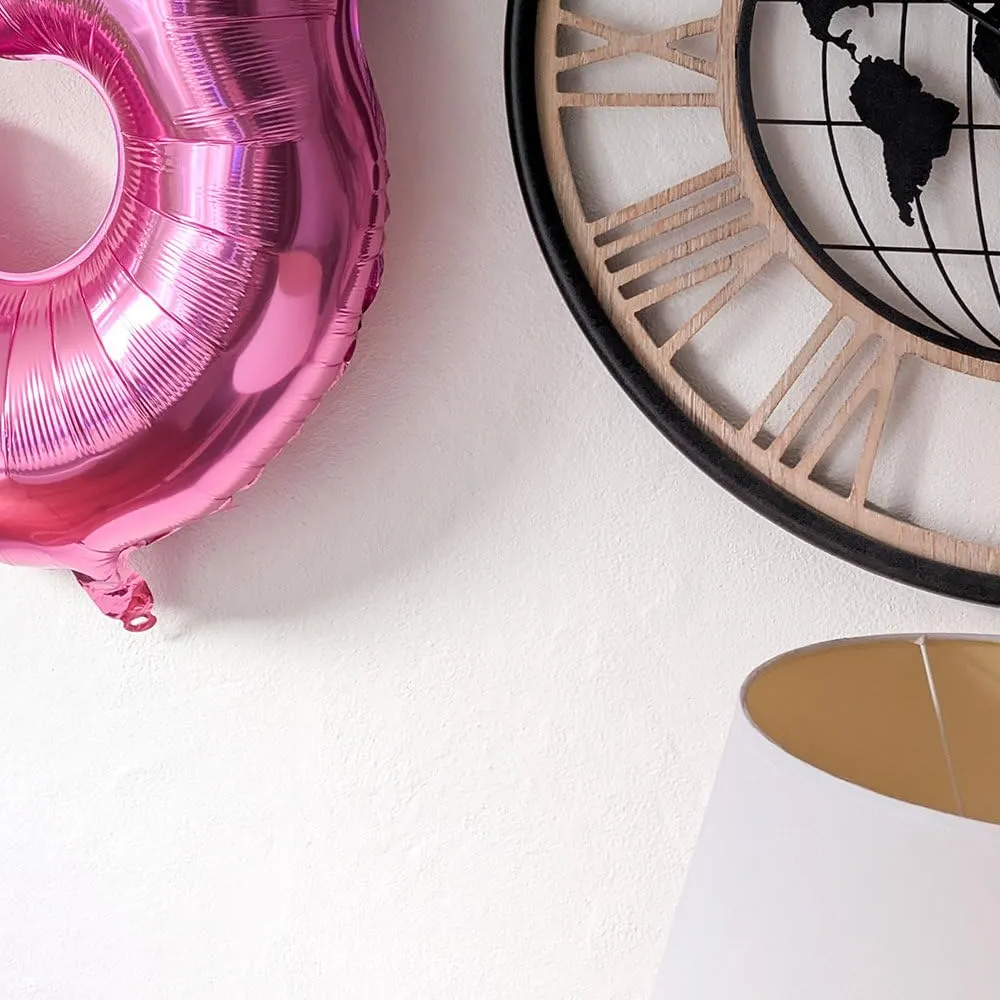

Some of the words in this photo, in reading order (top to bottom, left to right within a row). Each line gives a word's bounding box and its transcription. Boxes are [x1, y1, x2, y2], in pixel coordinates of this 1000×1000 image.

[555, 8, 722, 108] IX
[586, 160, 788, 362] VIII
[740, 304, 904, 506] VII
